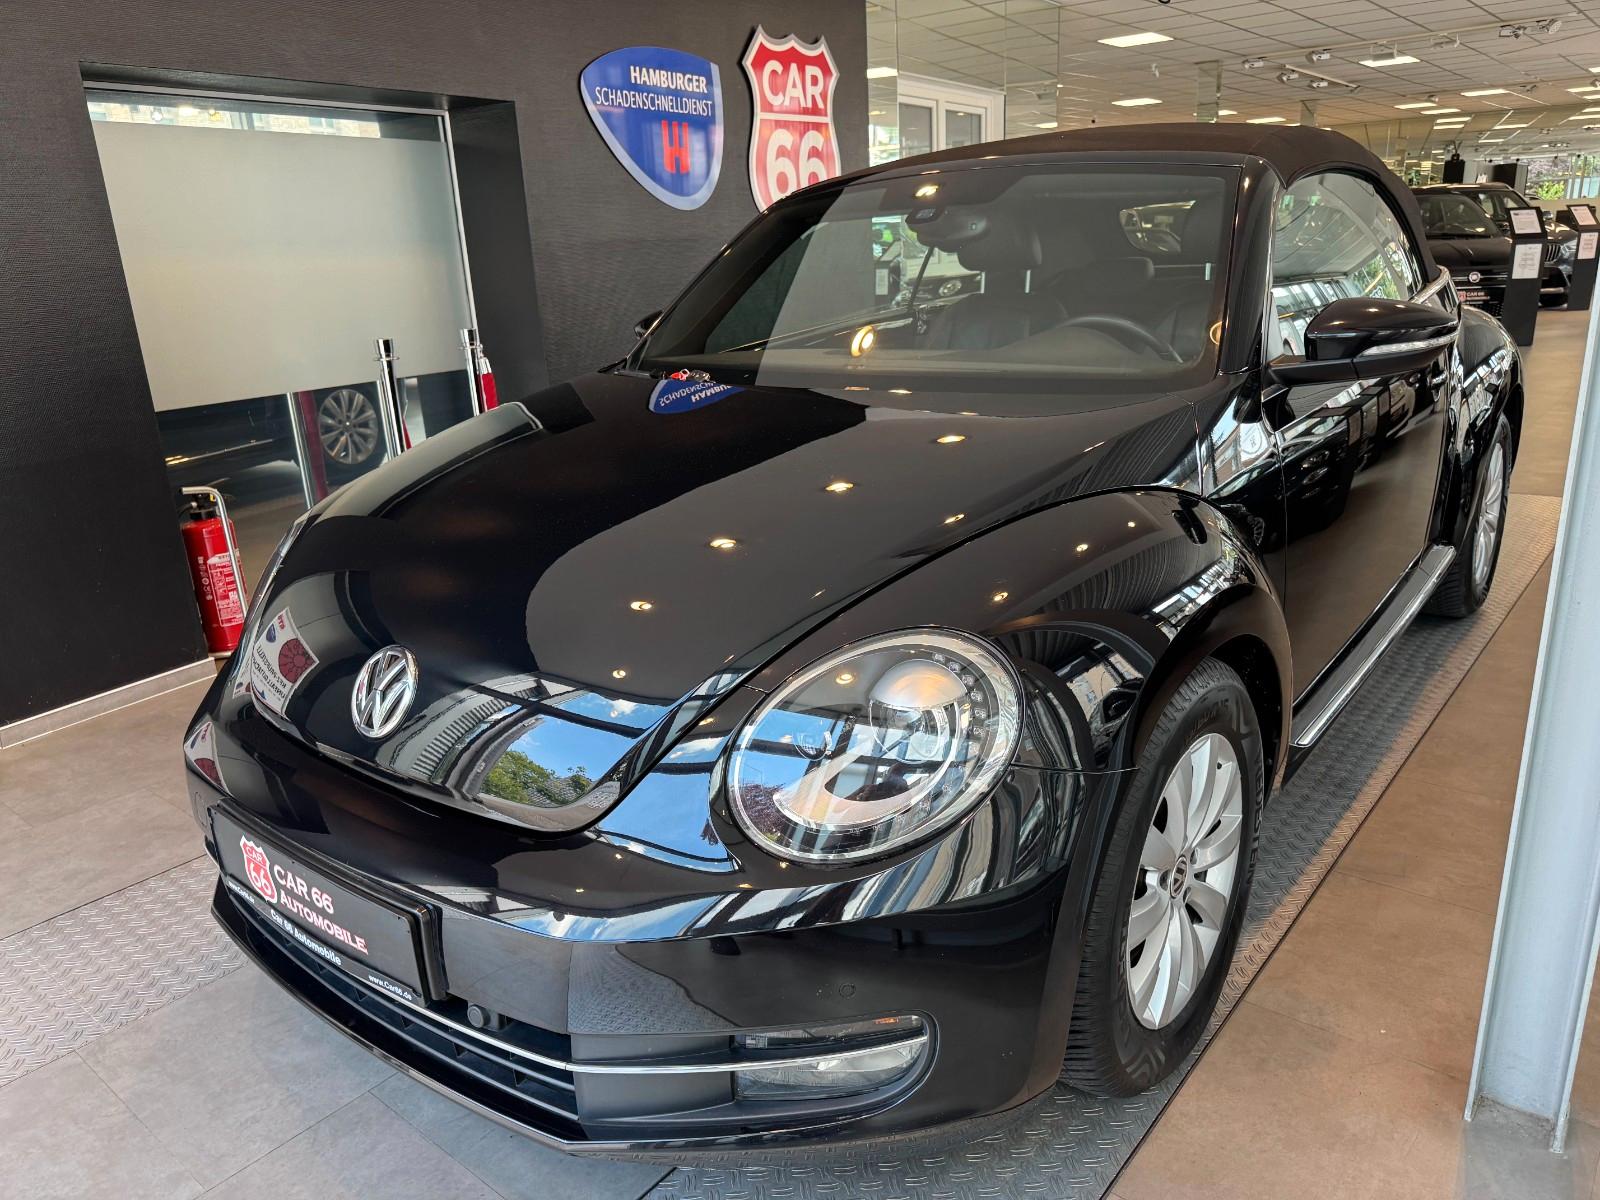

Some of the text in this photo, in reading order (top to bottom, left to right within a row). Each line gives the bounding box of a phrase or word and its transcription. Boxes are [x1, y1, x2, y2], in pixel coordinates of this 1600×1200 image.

[595, 86, 713, 117] SCHADENSCHNELLDIENST
[630, 65, 708, 93] HAMBURGER
[762, 60, 824, 109] CAR
[767, 128, 827, 201] 66
[246, 846, 263, 864] CAR
[250, 862, 272, 895] 66
[273, 864, 334, 914] CAR 66
[270, 908, 283, 926] Car
[294, 927, 342, 966] Automobile
[280, 889, 369, 955] AUTOMOBILE
